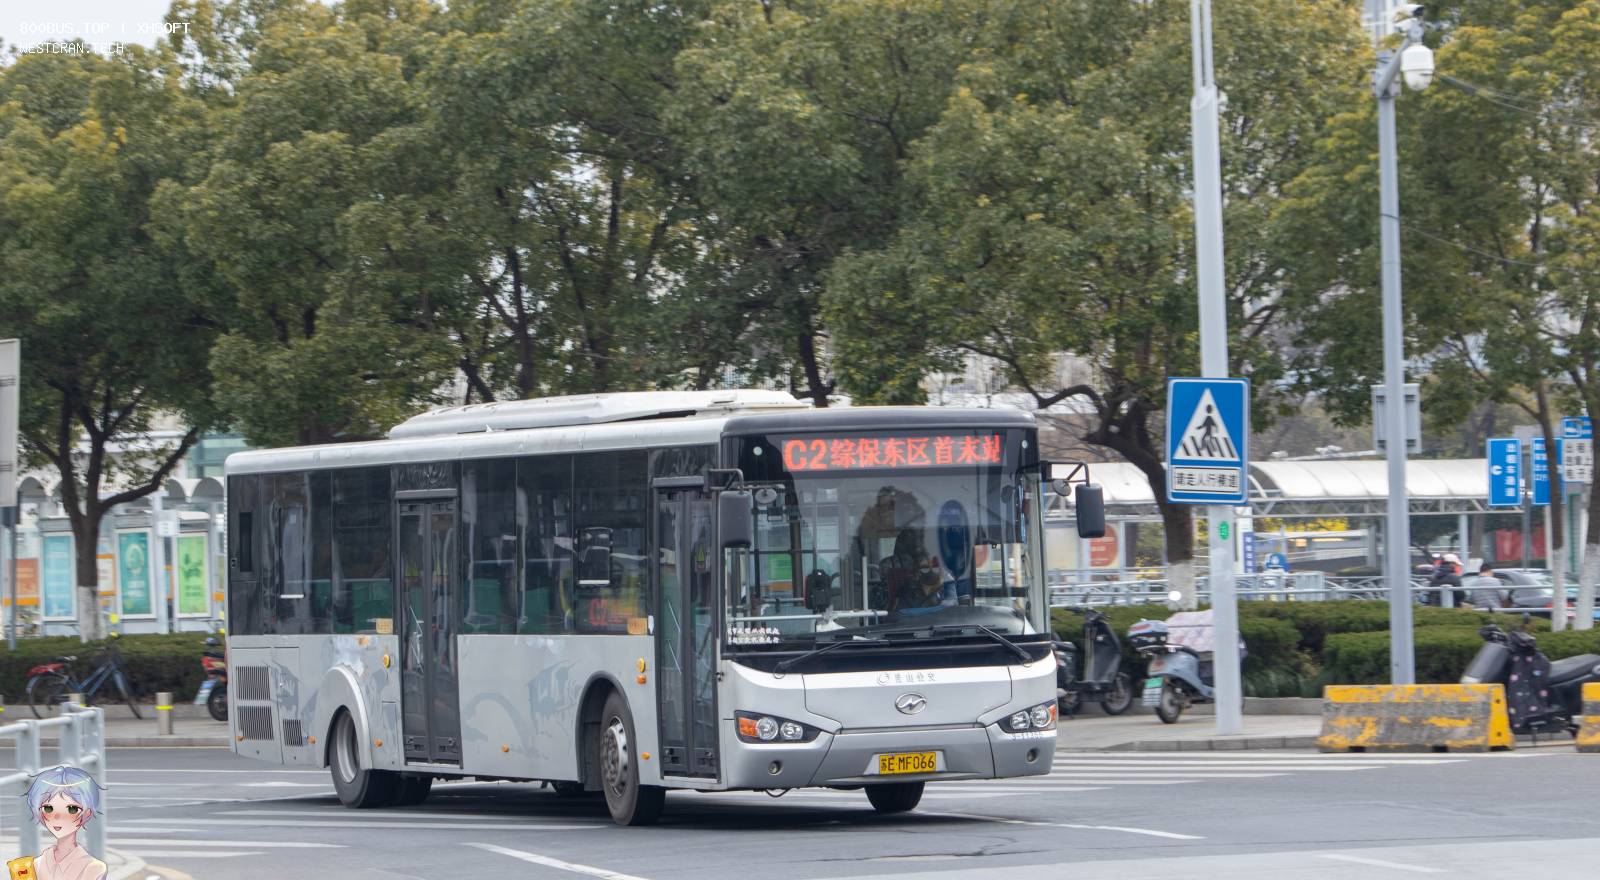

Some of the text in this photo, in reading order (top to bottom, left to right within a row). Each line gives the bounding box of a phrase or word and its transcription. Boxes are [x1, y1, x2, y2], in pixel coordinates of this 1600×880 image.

[783, 439, 828, 472] C2
[1175, 472, 1239, 488] 请走人行横道
[894, 671, 936, 684] 昆山公交
